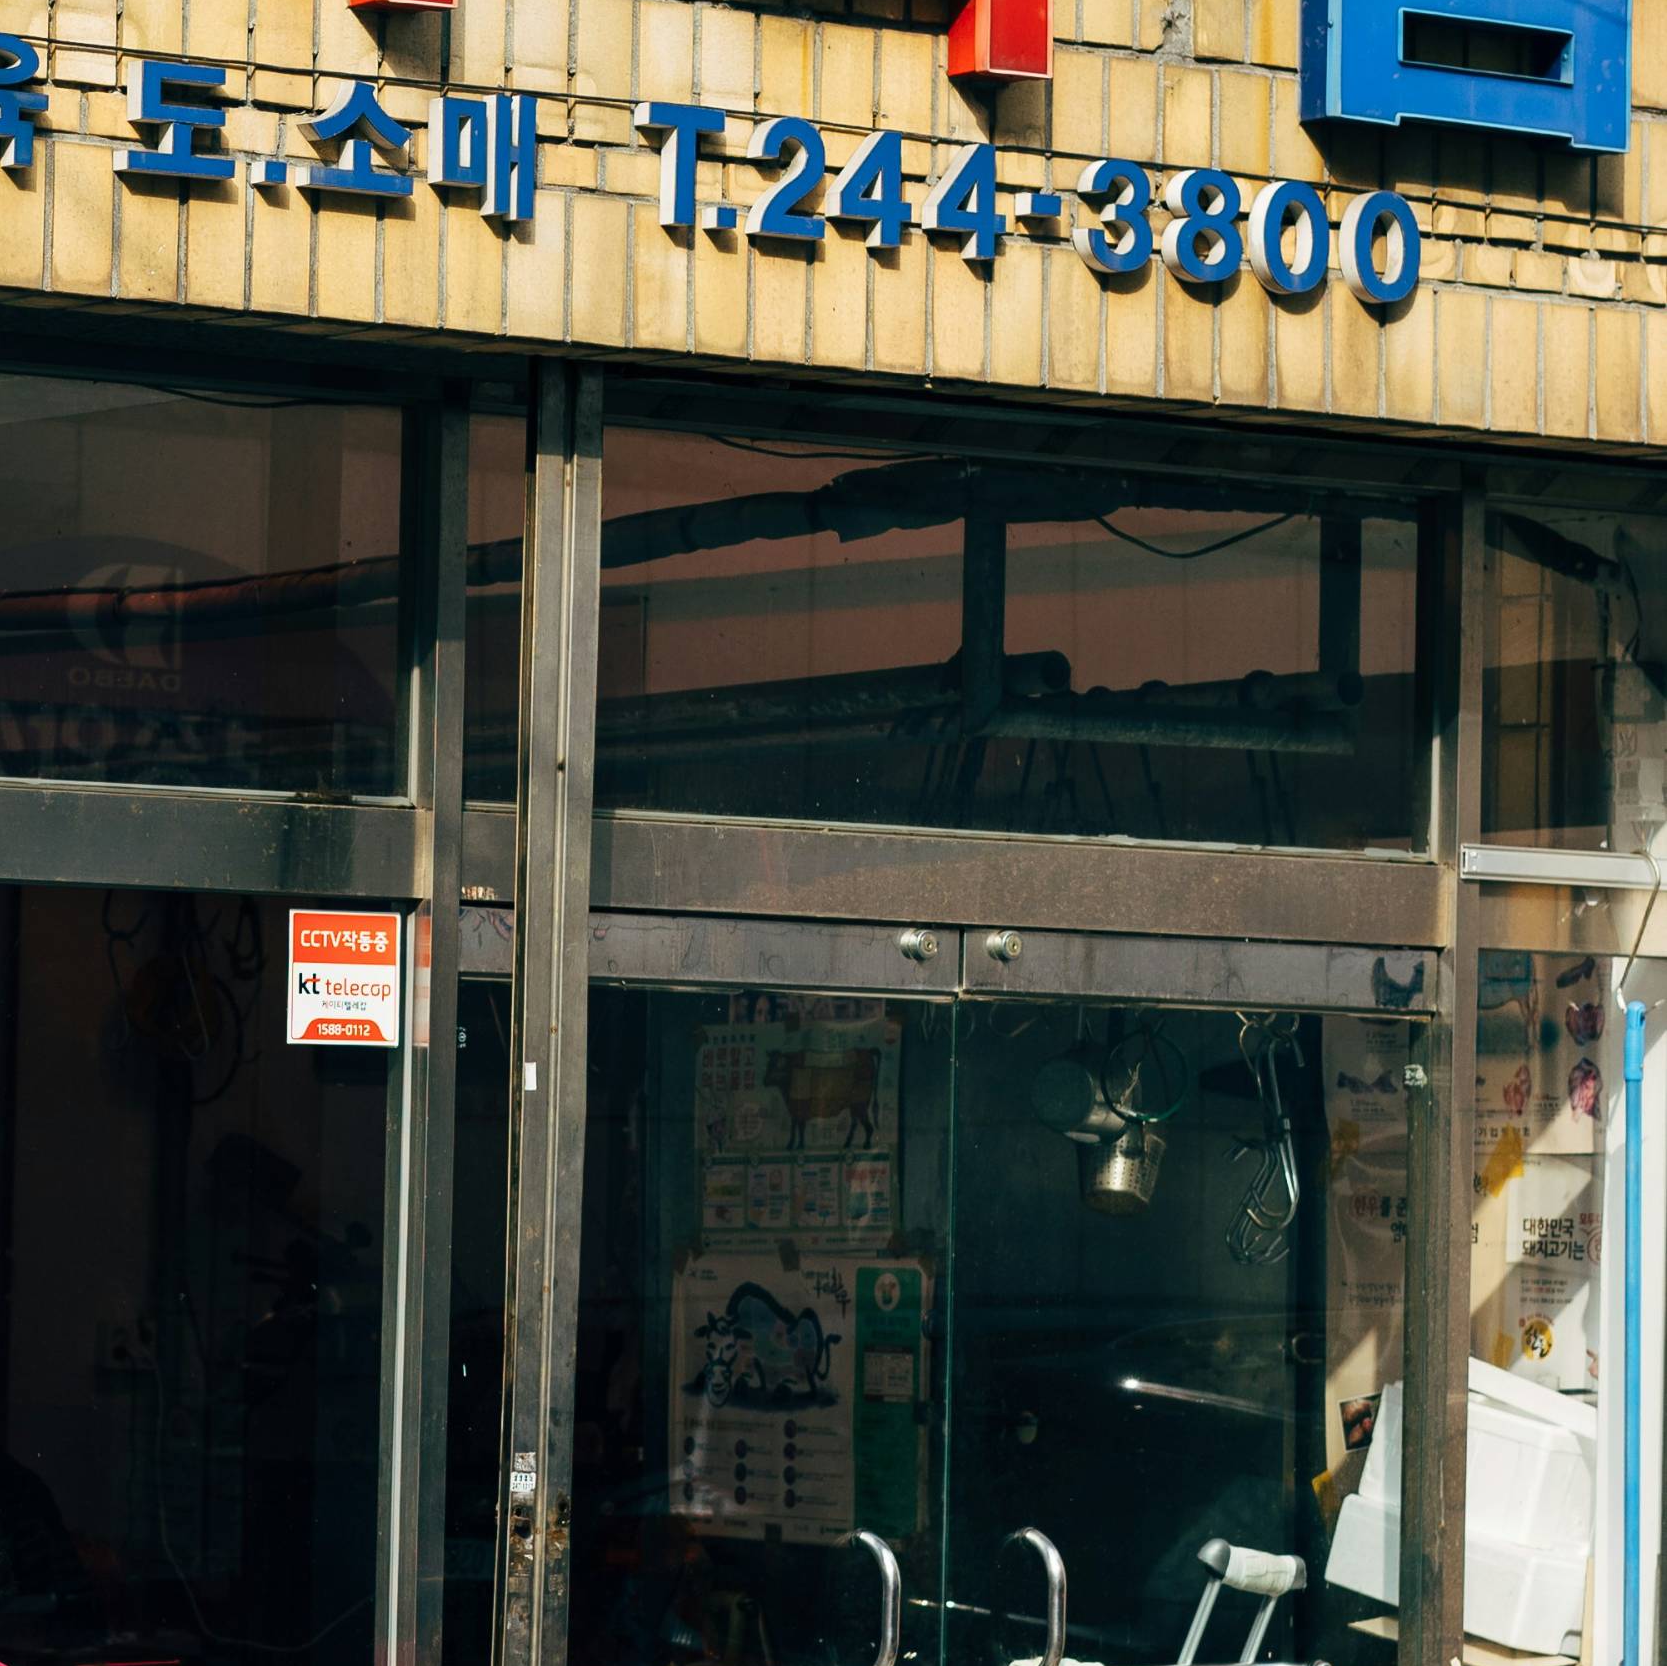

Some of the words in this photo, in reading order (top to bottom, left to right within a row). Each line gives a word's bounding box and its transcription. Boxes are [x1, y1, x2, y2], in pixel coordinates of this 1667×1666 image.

[113, 58, 538, 223] 도.소매
[634, 100, 1422, 307] T.244-3800
[300, 930, 389, 953] CCTV작동중
[298, 972, 321, 995] kt
[326, 978, 391, 1001] telecop
[317, 1023, 370, 1036] 1588-0112
[1522, 1218, 1574, 1238] 대한민국
[1521, 1240, 1585, 1261] 돼지고기는
